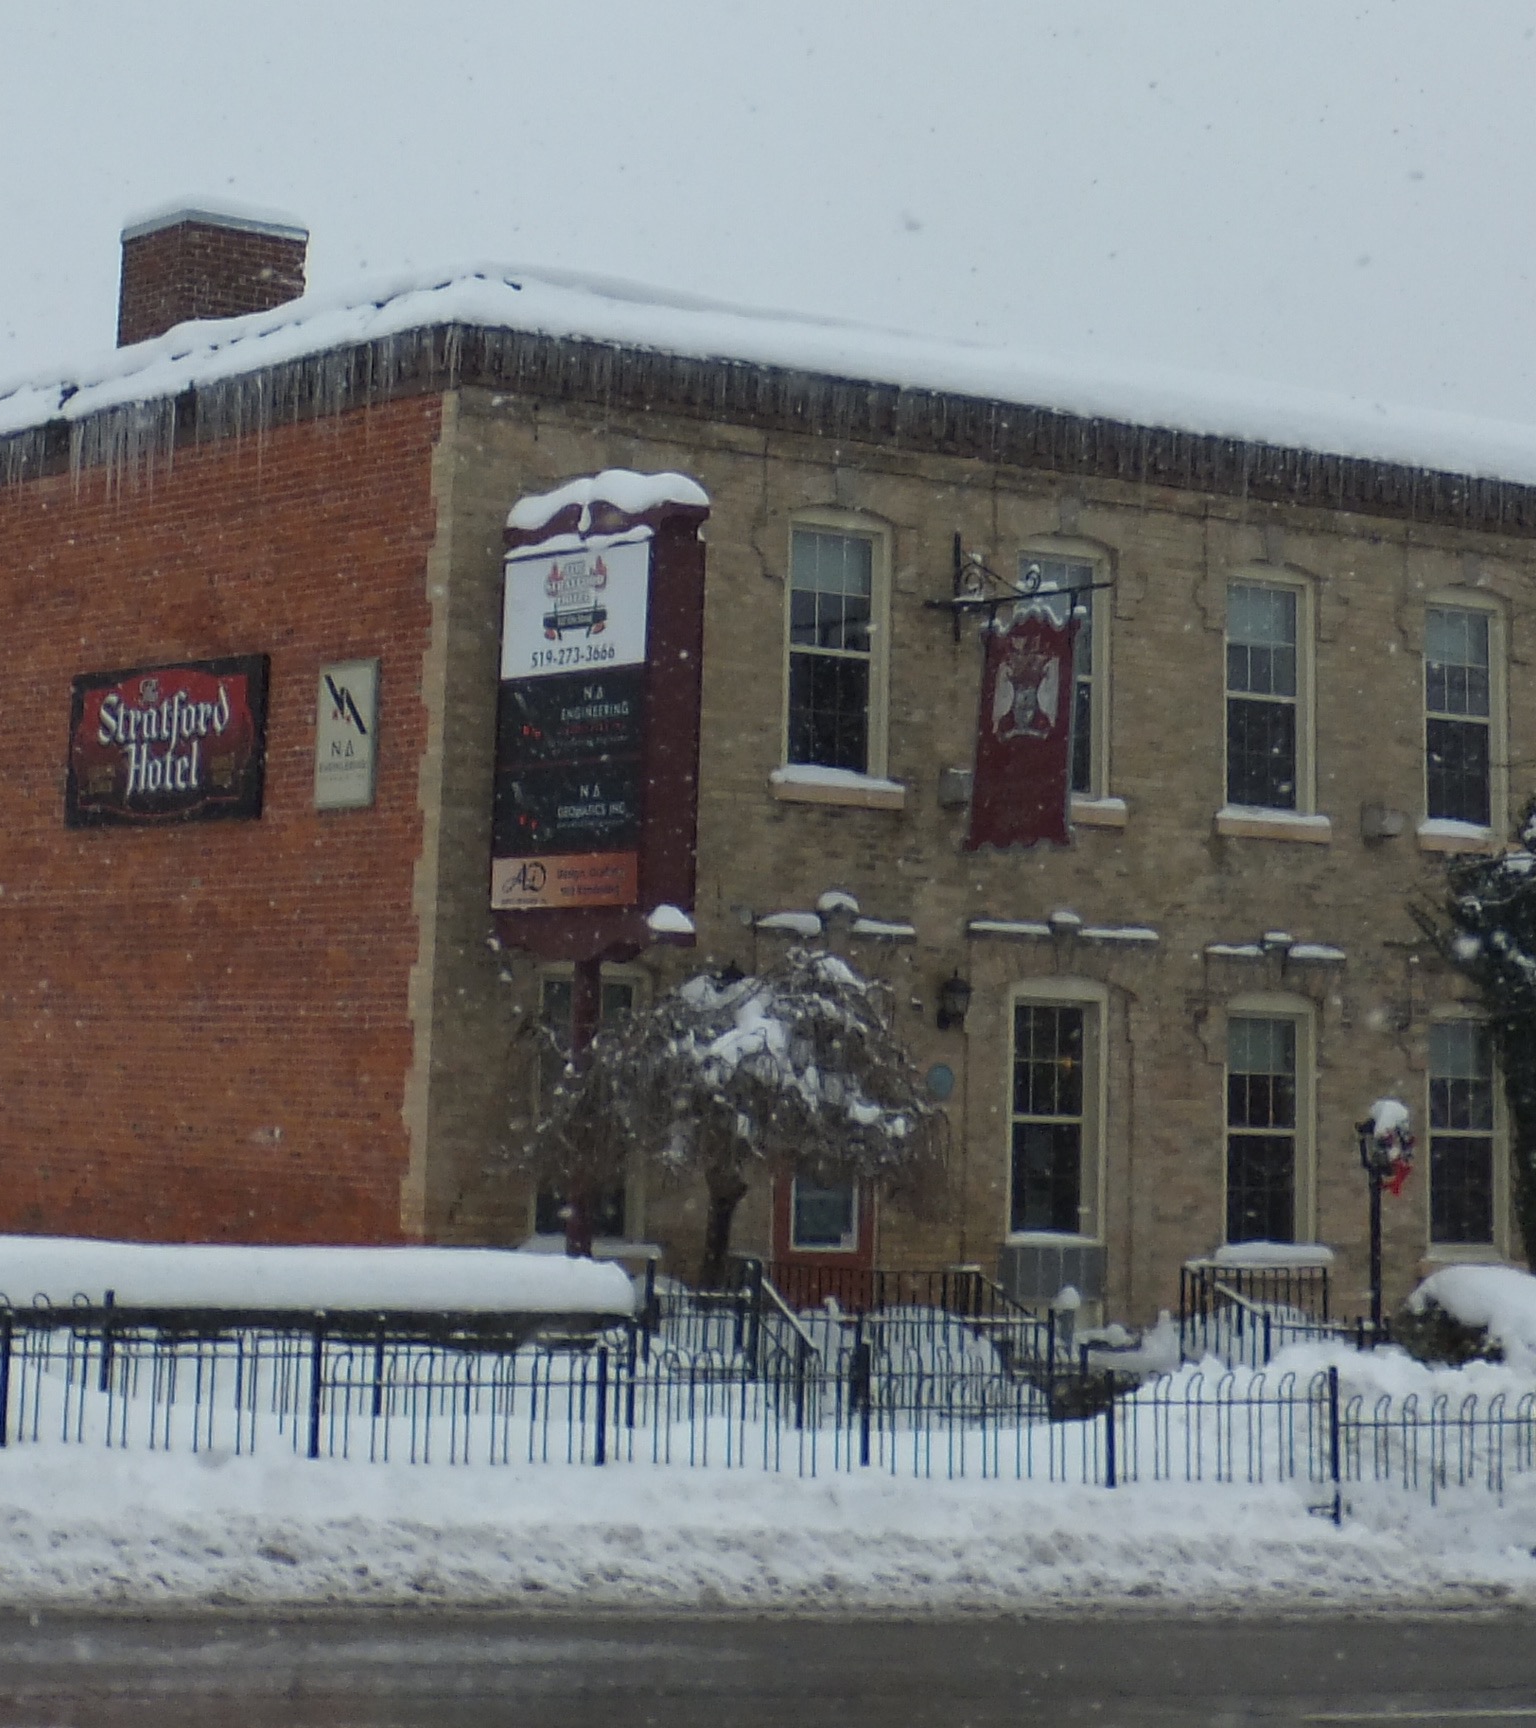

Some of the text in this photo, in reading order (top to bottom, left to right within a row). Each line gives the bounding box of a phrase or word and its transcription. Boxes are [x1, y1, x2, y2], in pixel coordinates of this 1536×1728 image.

[531, 644, 616, 668] 519-273-3666
[97, 682, 230, 750] Stratford
[560, 701, 629, 720] ENGINEERING
[124, 739, 199, 799] Hotel
